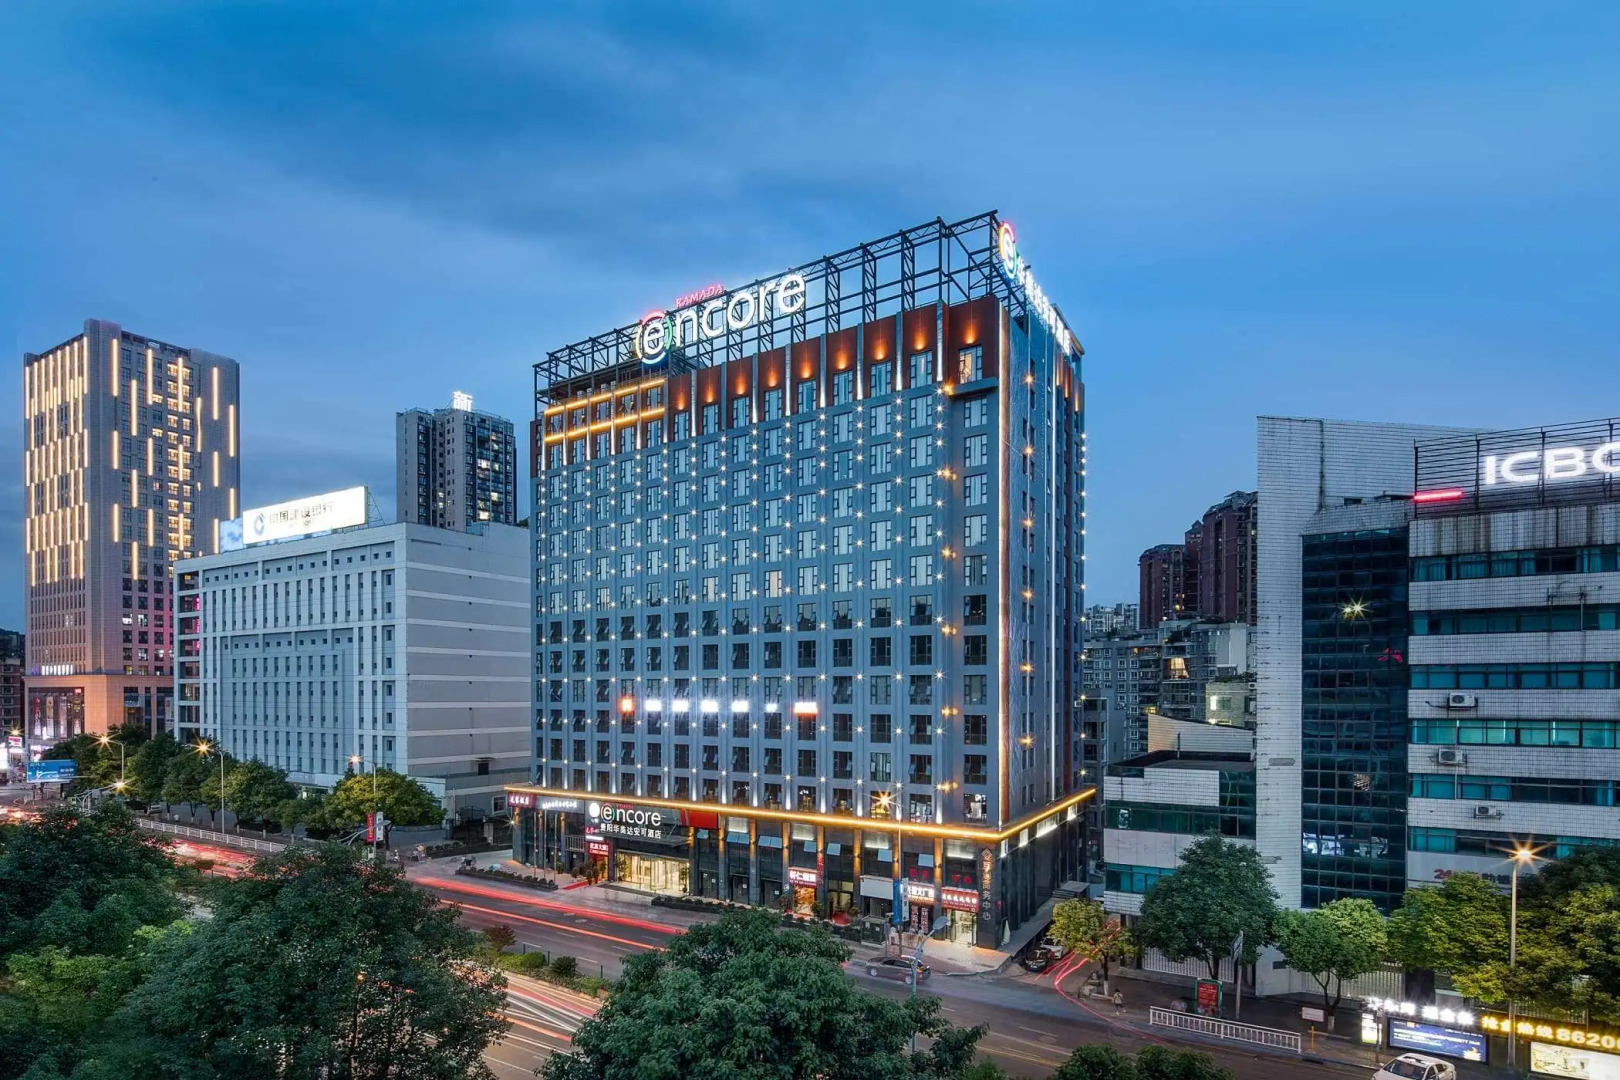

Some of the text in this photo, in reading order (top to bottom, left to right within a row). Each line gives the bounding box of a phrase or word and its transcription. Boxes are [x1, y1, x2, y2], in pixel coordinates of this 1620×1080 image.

[675, 284, 725, 308] RAMADA
[638, 274, 806, 362] encore
[603, 806, 662, 827] encore
